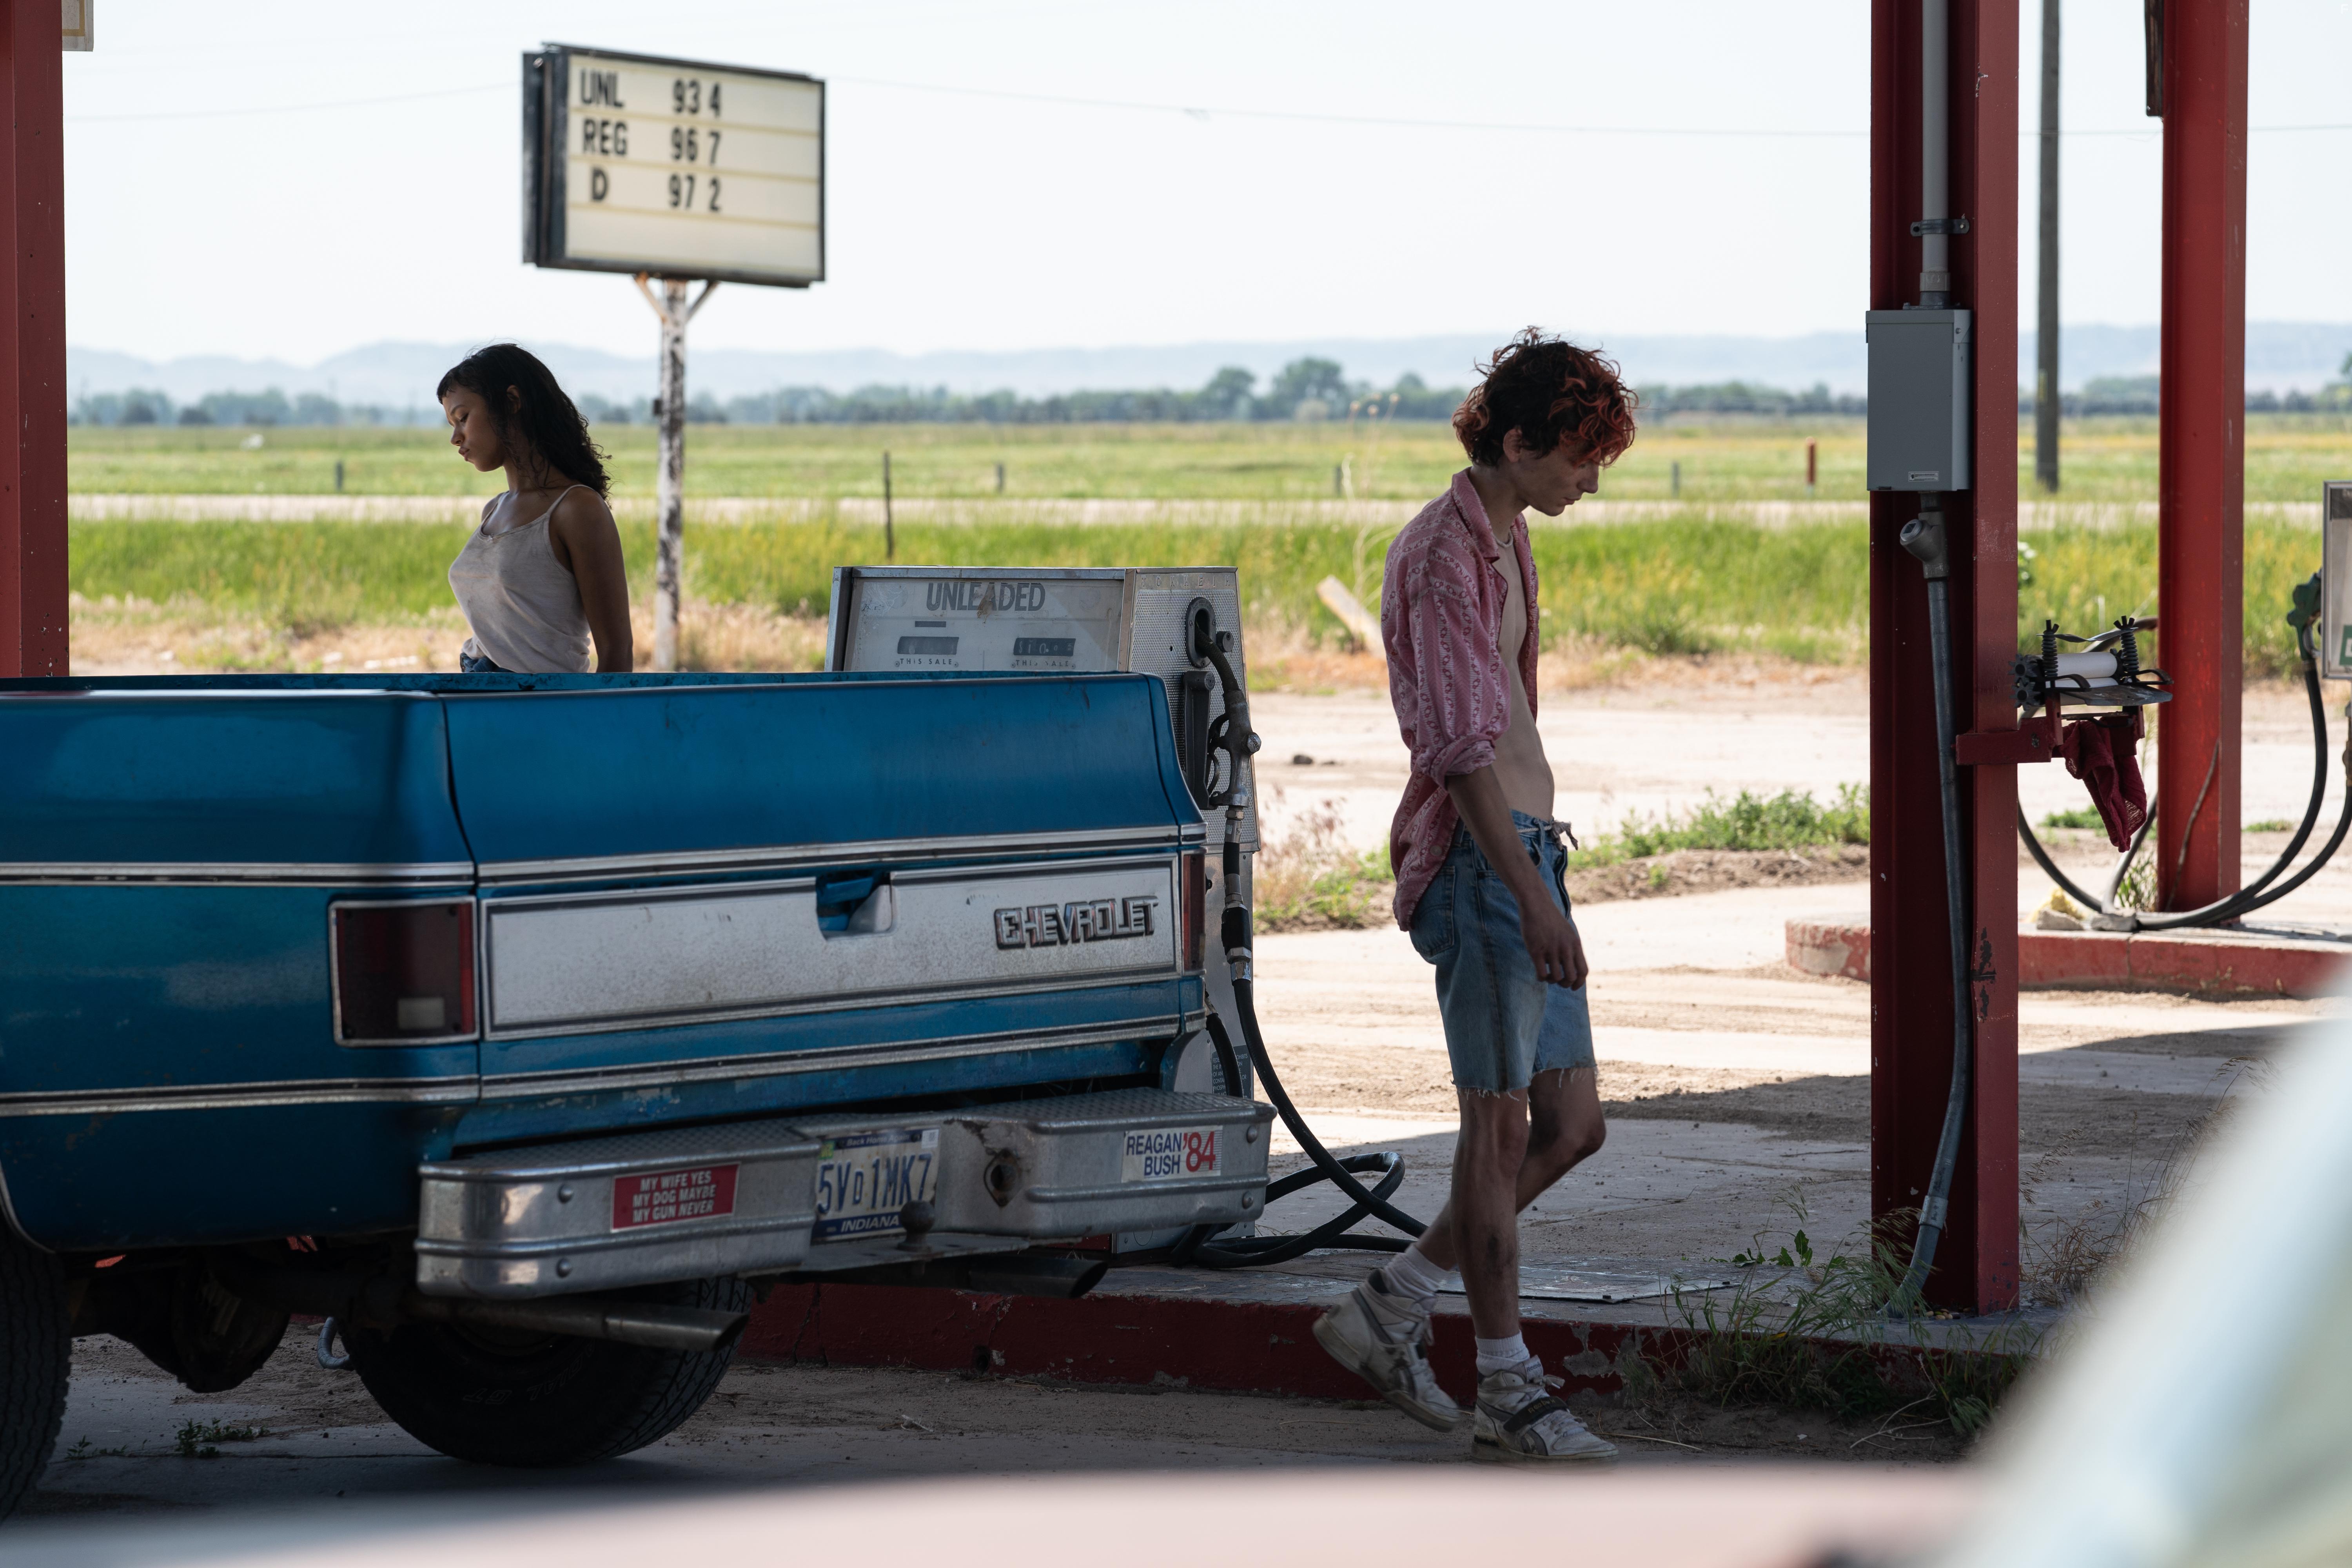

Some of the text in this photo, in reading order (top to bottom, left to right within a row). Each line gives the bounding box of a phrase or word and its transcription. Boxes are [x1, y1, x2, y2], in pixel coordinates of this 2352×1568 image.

[581, 68, 625, 108] UNL
[583, 118, 628, 155] REG
[592, 167, 609, 202] D
[1141, 574, 1232, 587] TOKHEIM
[926, 582, 1046, 611] UNLEADED
[994, 895, 1159, 950] CHEVROLET
[846, 1138, 865, 1147] Back
[1127, 1133, 1182, 1155] REAGAN
[1183, 1131, 1216, 1172] '84
[1144, 1154, 1181, 1176] BUSH
[641, 1171, 711, 1191] MY WIFE YES
[633, 1185, 716, 1207] MY DOG MAYBE
[633, 1200, 713, 1222] MY GUN NEVER
[840, 1215, 899, 1233] INDIANA
